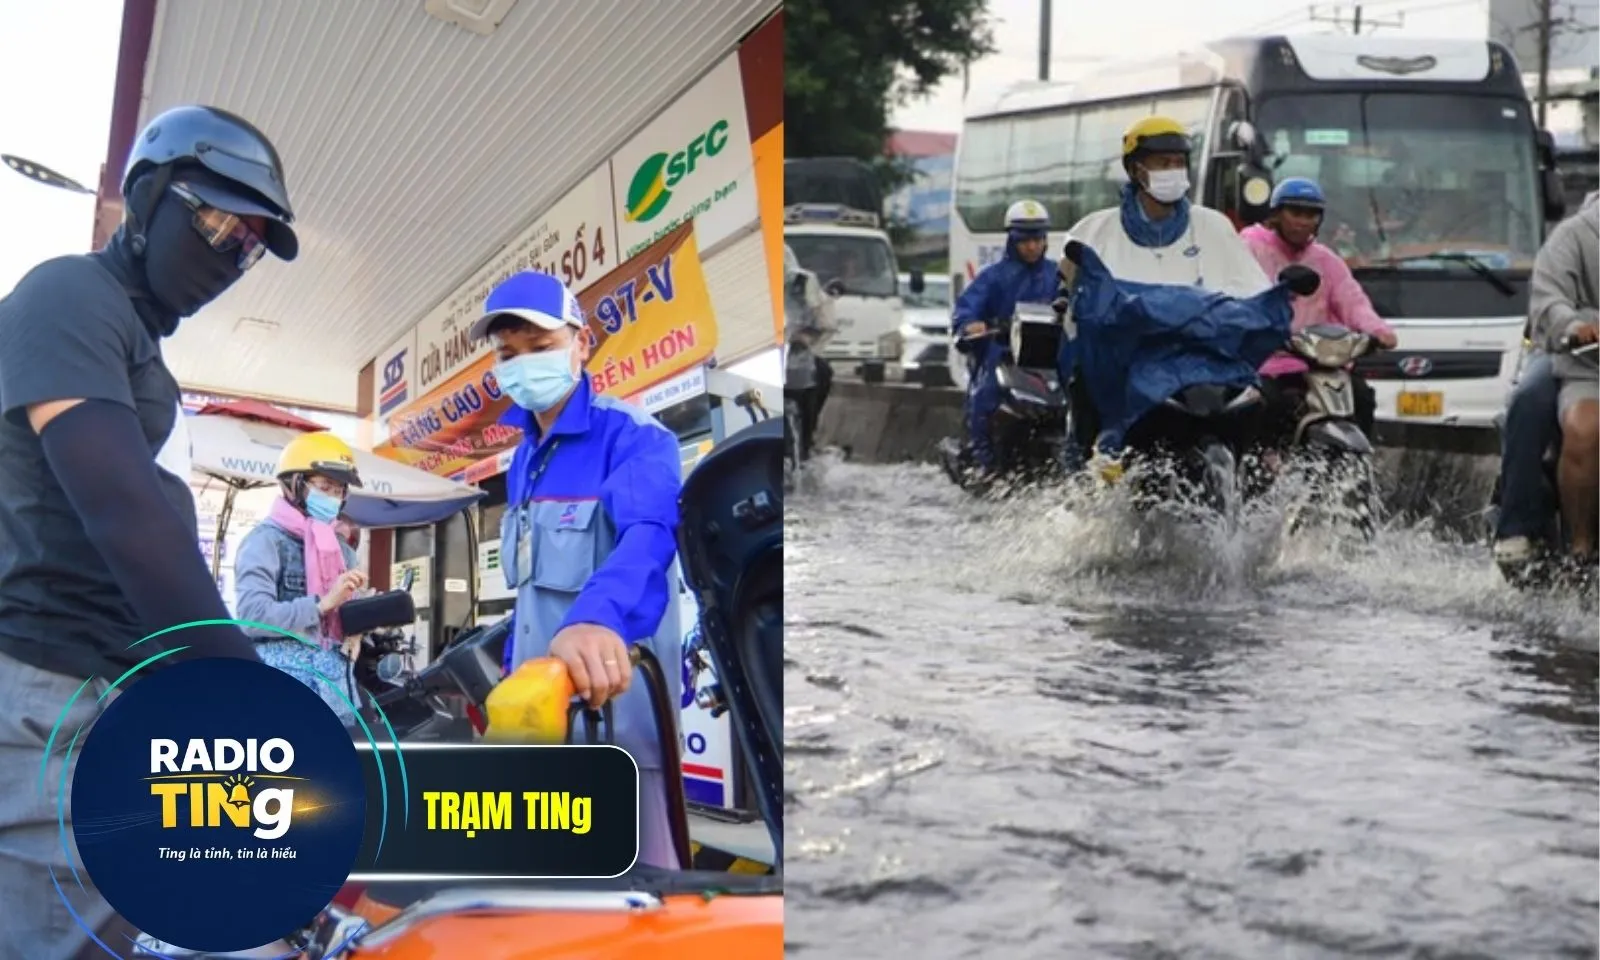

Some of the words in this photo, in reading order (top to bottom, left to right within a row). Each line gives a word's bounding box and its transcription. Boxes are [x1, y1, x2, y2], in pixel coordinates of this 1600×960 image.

[665, 120, 728, 187] SFC
[561, 222, 586, 288] SỐ
[593, 226, 605, 265] 4
[592, 357, 635, 394] BỀN
[642, 325, 695, 369] HƠN
[441, 383, 482, 422] CAO
